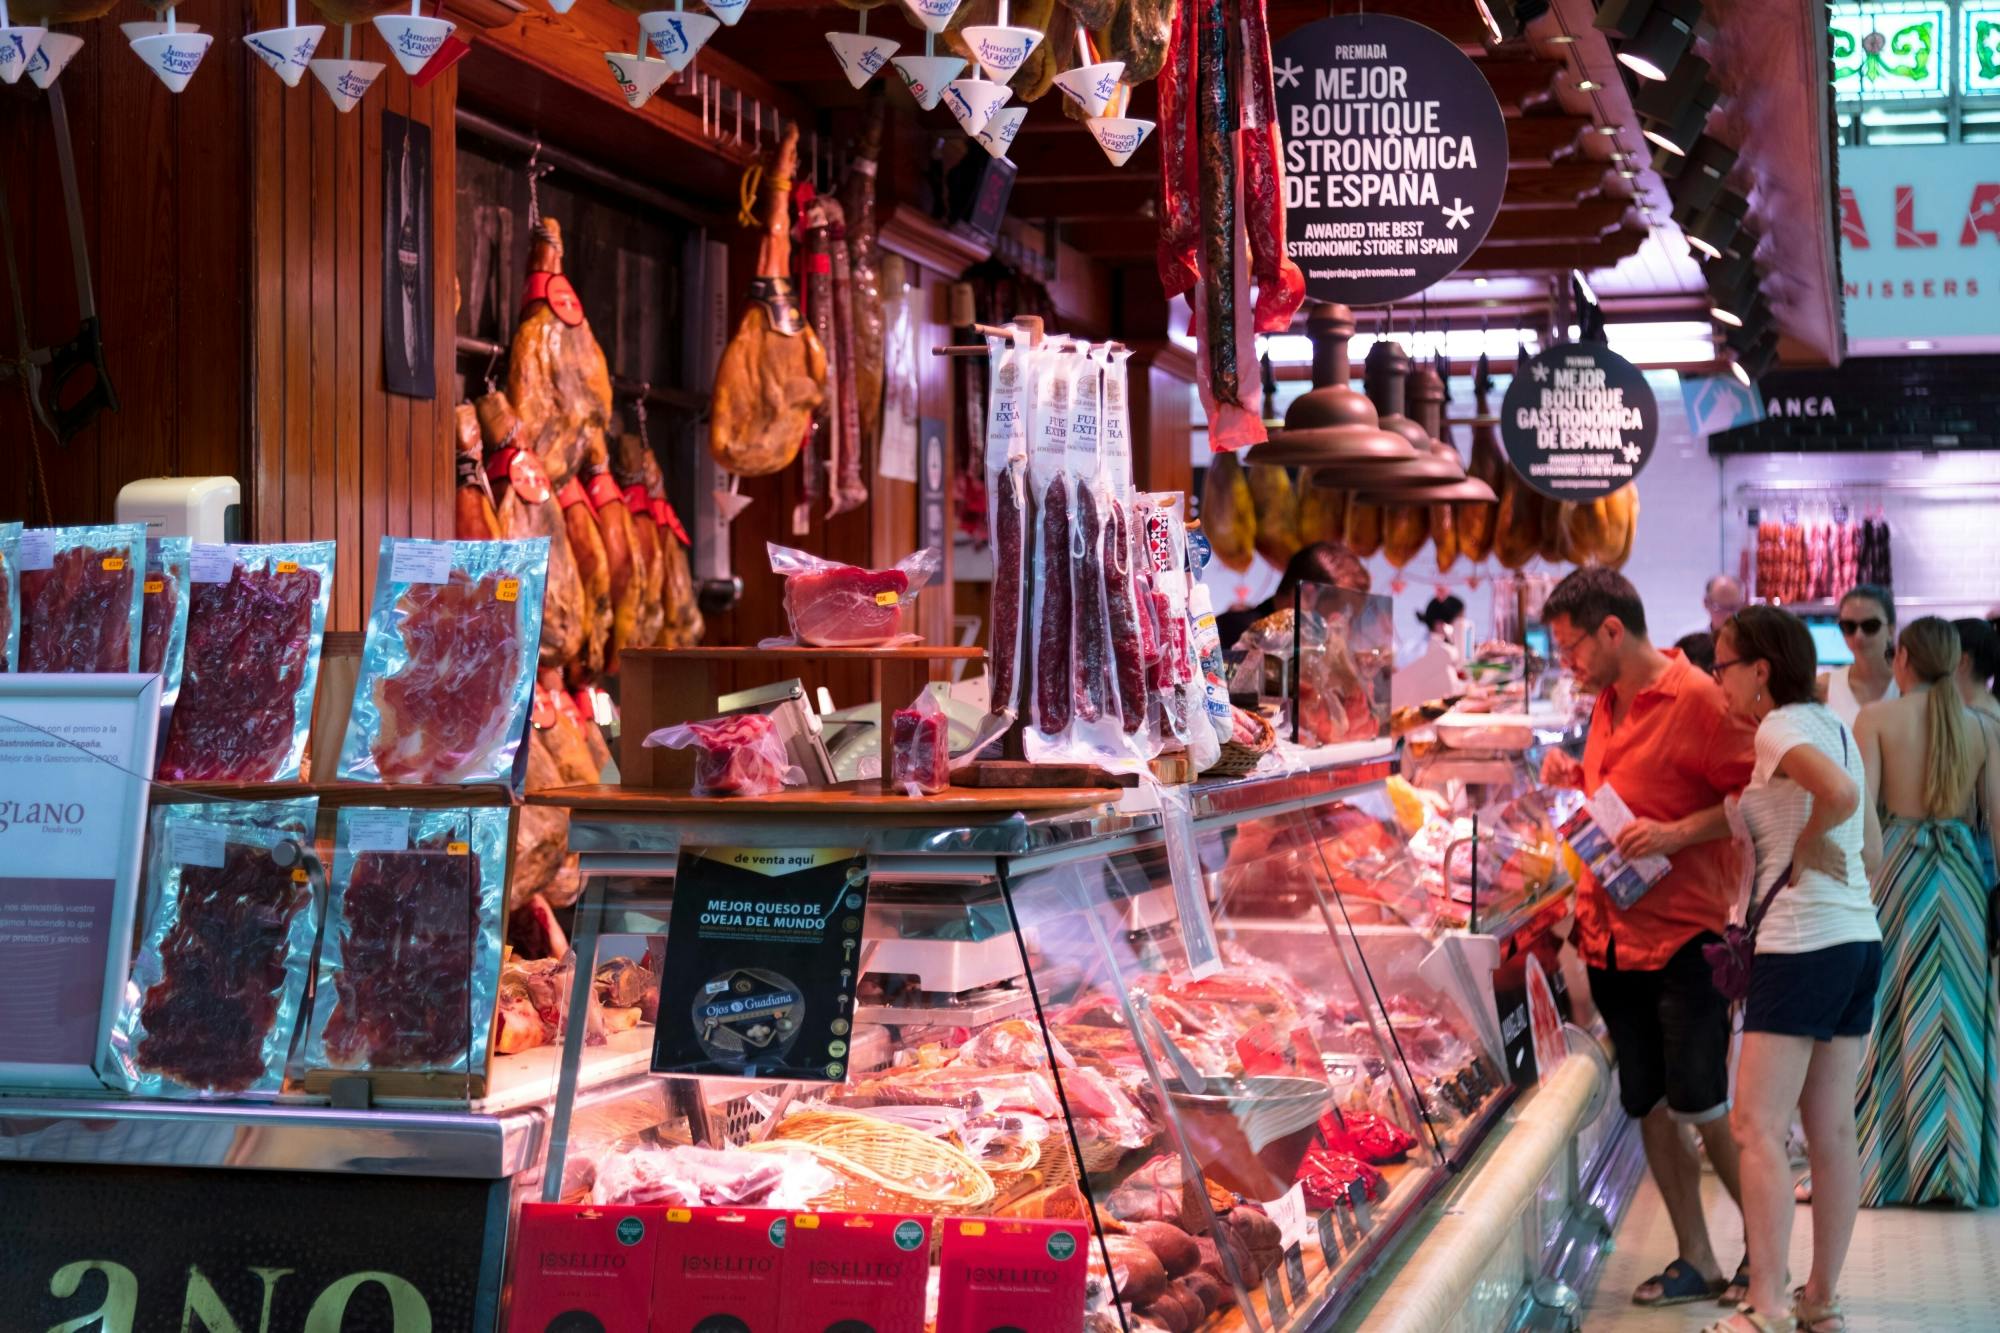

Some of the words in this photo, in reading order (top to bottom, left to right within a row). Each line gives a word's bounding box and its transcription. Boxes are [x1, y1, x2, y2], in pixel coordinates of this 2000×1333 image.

[980, 38, 1022, 53] Jamones
[1335, 44, 1387, 60] PREMIADA
[1315, 66, 1407, 100] MEJOR
[1291, 101, 1440, 137] BOUTIQUE
[1286, 134, 1477, 173] STRONÓMICA
[1286, 175, 1320, 208] DE
[1327, 170, 1440, 207] ESPAÑA
[1305, 222, 1365, 239] AWARDED
[1367, 221, 1390, 238] THE
[1392, 221, 1424, 237] BEST
[1363, 240, 1403, 255] STORE
[1405, 239, 1419, 254] IN
[1421, 238, 1458, 254] SPAIN
[1554, 368, 1606, 389] MEJOR
[1541, 387, 1623, 410] BOUTIQUE
[1767, 397, 1836, 417] ANCA
[1537, 429, 1558, 449] DE
[73, 725, 101, 735] premio
[734, 853, 750, 864] de
[752, 856, 784, 864] venta
[788, 854, 815, 866] aquí
[708, 900, 752, 912] MEJOR
[755, 903, 800, 915] QUESO
[803, 904, 821, 915] DE
[701, 913, 742, 925] OVEJA
[746, 916, 770, 927] DEL
[774, 917, 825, 929] MUNDO
[706, 1006, 729, 1018] Ojos
[539, 1252, 626, 1268] JOSELITO
[682, 1256, 773, 1273] JOSELITO
[808, 1260, 902, 1278] JOSELITO
[965, 1265, 1058, 1284] JOSELITO
